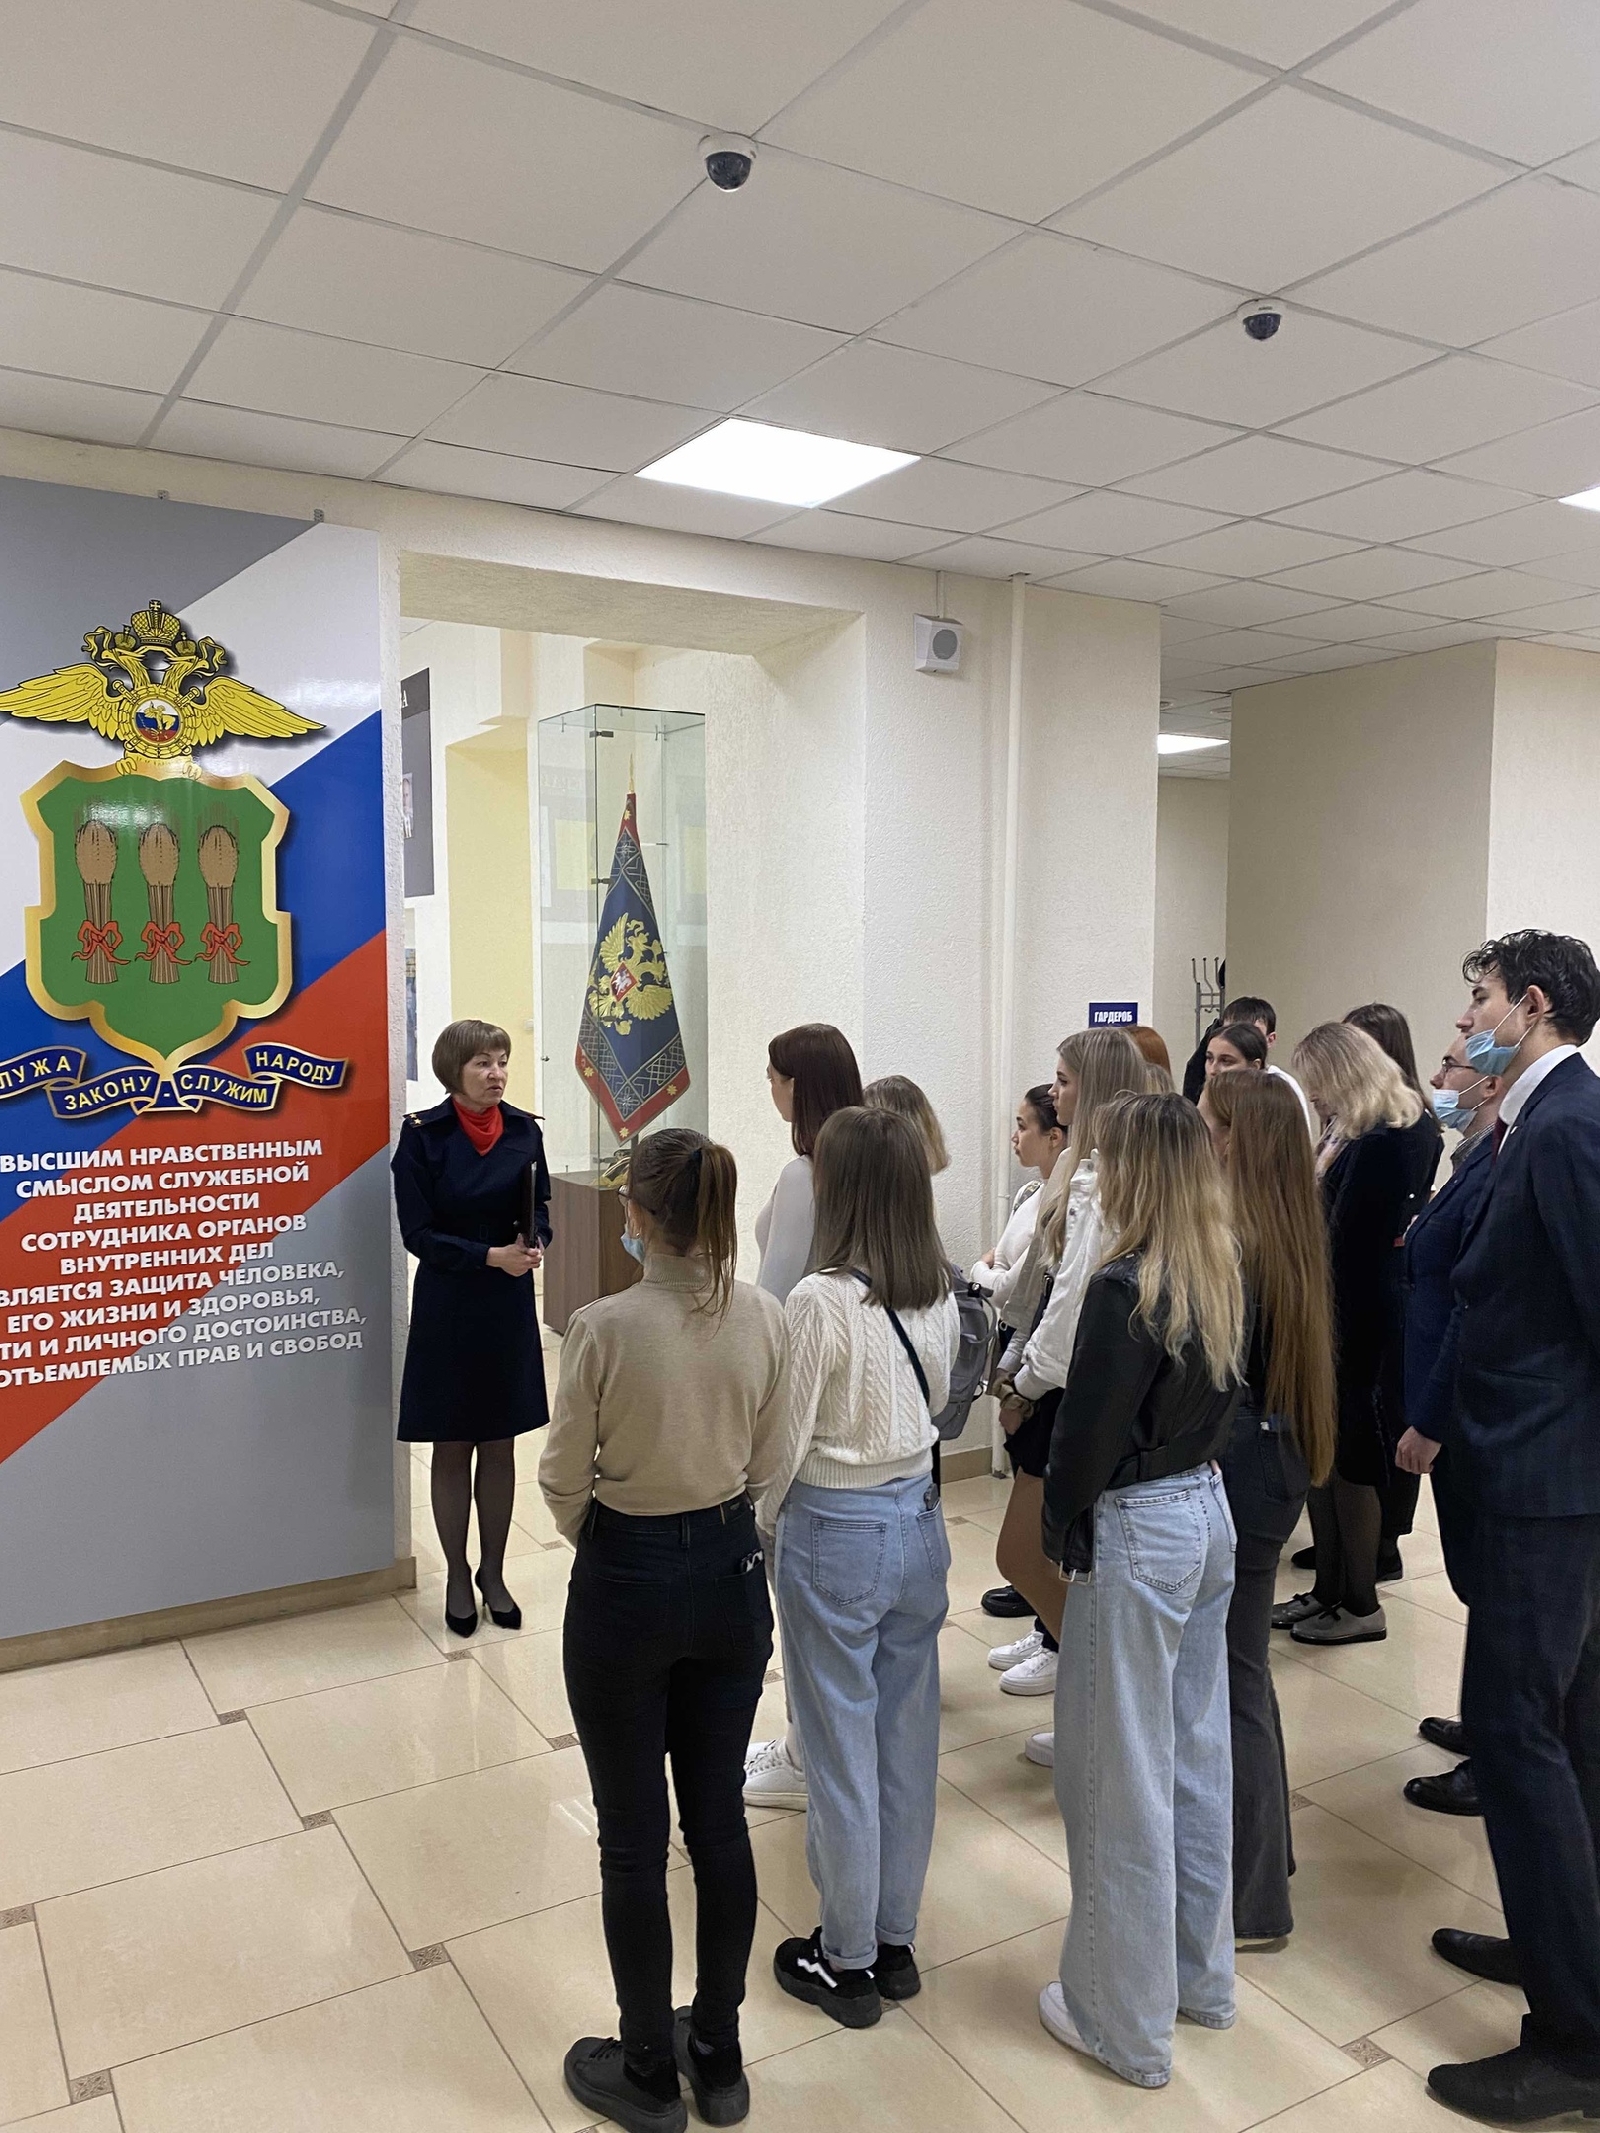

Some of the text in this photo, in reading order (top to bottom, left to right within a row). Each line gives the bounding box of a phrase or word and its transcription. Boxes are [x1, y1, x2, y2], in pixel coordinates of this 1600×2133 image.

[1094, 1011, 1133, 1024] ГАРДЕРОБ
[0, 1056, 71, 1090] ЛУЖА
[64, 1076, 152, 1111] ЗАКОНУ
[180, 1074, 268, 1104] СЛУЖИМ
[255, 1051, 335, 1083] НАРОДУ
[0, 1139, 323, 1173] ВЫСШИМ НРАВСТВЕННЫМ
[16, 1160, 309, 1198] СМЫСЛОМ СЛУЖЕБНОЙ
[73, 1192, 260, 1225] ДЕЯТЕЛЬНОСТИ
[21, 1214, 307, 1252] СОТРУДНИКА ОРГАНОВ
[60, 1242, 274, 1275] ВНУТРЕННИХ ДЕЛ
[0, 1261, 345, 1308] ВЛЯЕТСЯ ЗАЩИТА ЧЕЛОВЕКА,
[7, 1287, 321, 1334] ЕГО ЖИЗНИ И ЗДОРОВЬЯ,
[39, 1338, 59, 1356] И
[65, 1325, 187, 1354] ЛИЧНОГО
[192, 1307, 367, 1343] ДОСТОИНСТВА,
[0, 1331, 363, 1388] ОТЪЕМЛЕМЫХ ПРАВ И СВОБОД
